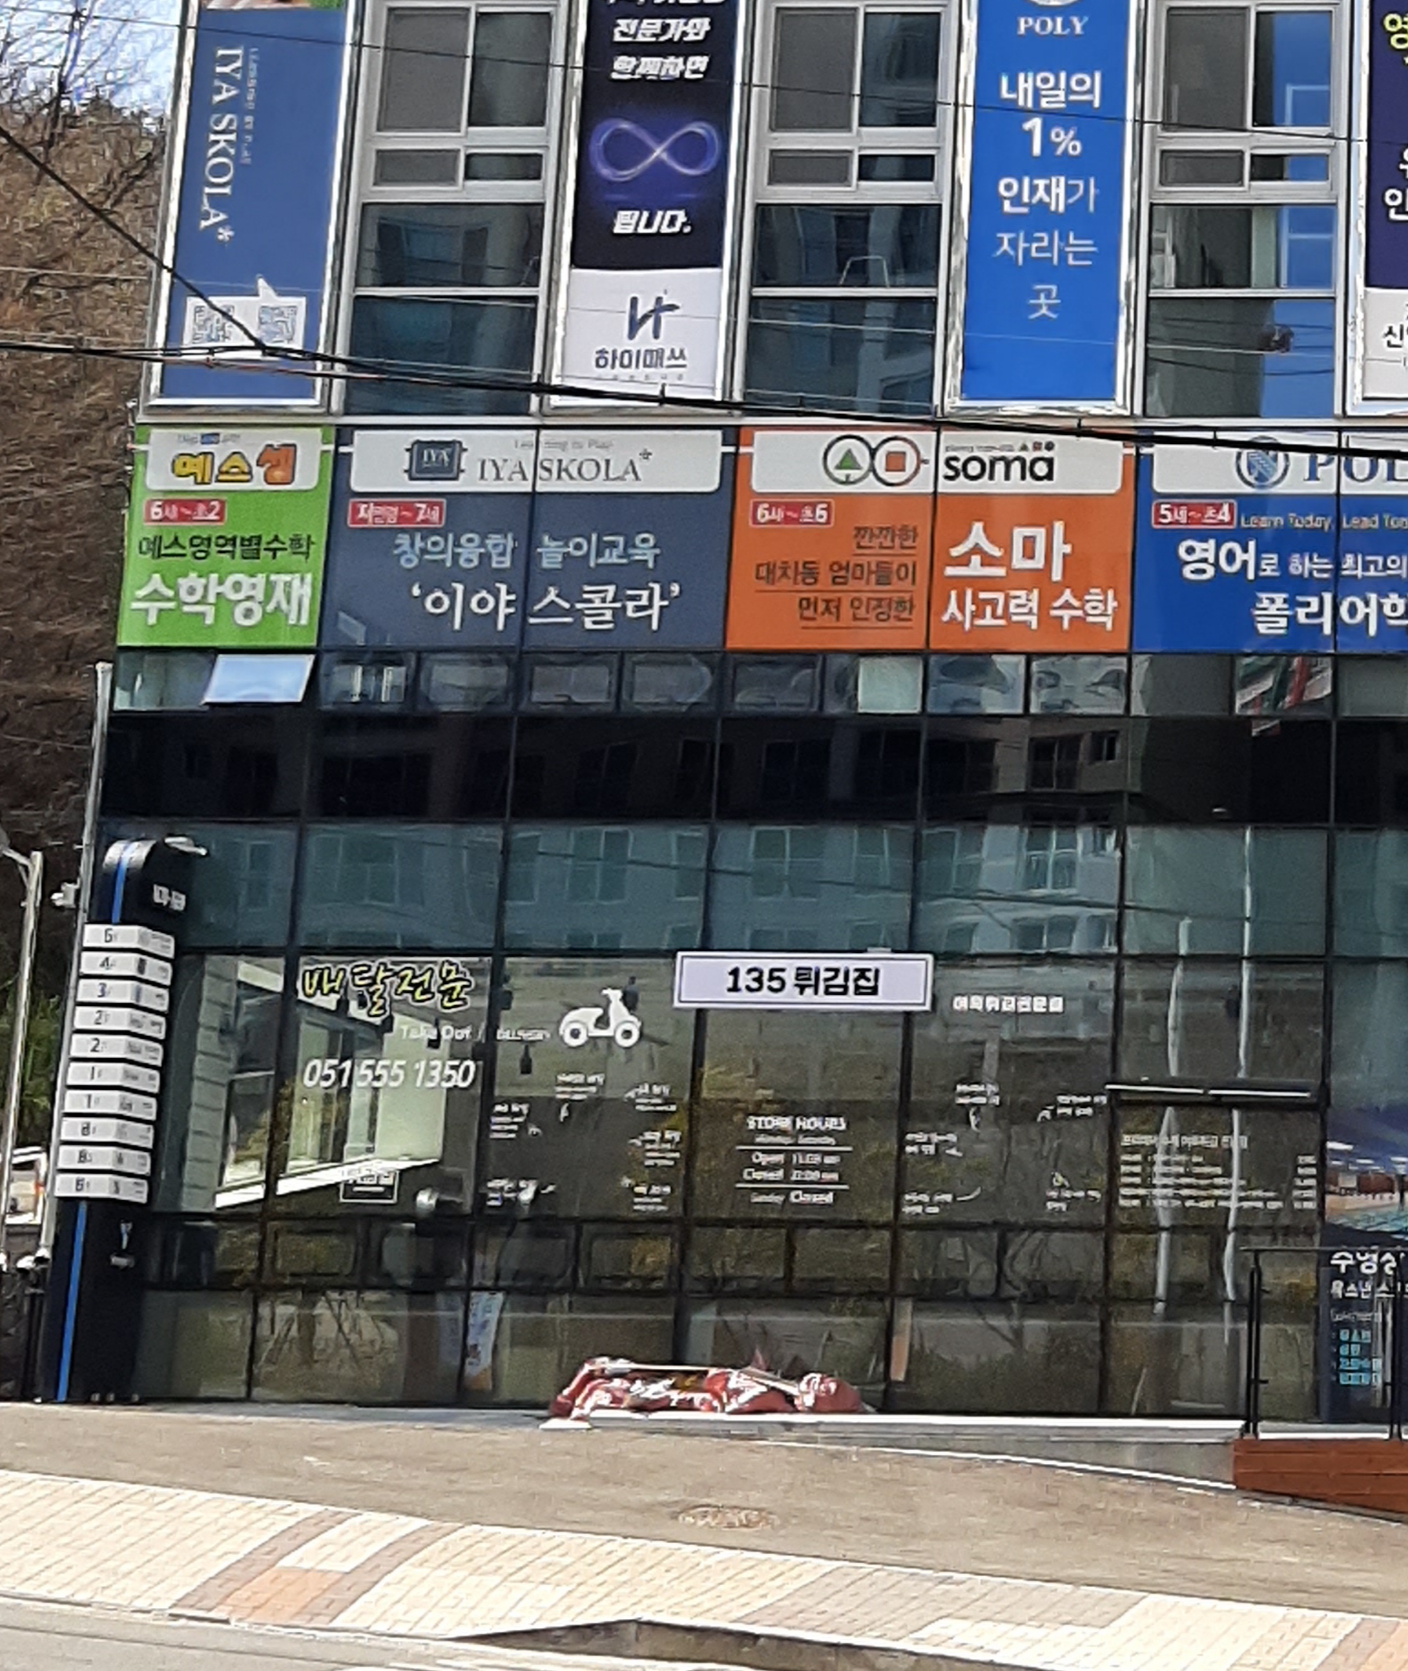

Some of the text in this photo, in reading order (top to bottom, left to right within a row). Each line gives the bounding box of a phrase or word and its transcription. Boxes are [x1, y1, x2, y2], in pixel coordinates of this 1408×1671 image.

[612, 16, 712, 43] 전문가와
[1016, 14, 1089, 36] POLY
[609, 54, 711, 80] 함께하면
[999, 70, 1103, 110] 내일의
[199, 45, 246, 231] IYA SKOLA
[1020, 117, 1082, 158] 1%
[997, 176, 1100, 215] 인재가
[612, 209, 693, 235] 됩니다.
[994, 231, 1099, 267] 자리는
[1027, 283, 1063, 321] 곳
[594, 347, 688, 370] 하이매쓰
[477, 458, 642, 482] IYA SKOLA
[942, 455, 1054, 482] soma
[392, 532, 662, 570] 창의융합 놀이교육
[943, 520, 1073, 584] 소마
[1177, 537, 1282, 582] 영어로
[1288, 553, 1335, 580] 하는
[1340, 553, 1408, 580] 최고의
[828, 560, 917, 586] 엄마들이
[130, 571, 313, 627] 수학영재
[798, 595, 916, 622] 먼저 인정한
[941, 588, 1119, 632] 사고력 수학
[301, 959, 475, 1018] 배달전문
[725, 966, 881, 997] 135 튀김집
[302, 1058, 477, 1089] 051 555 1350
